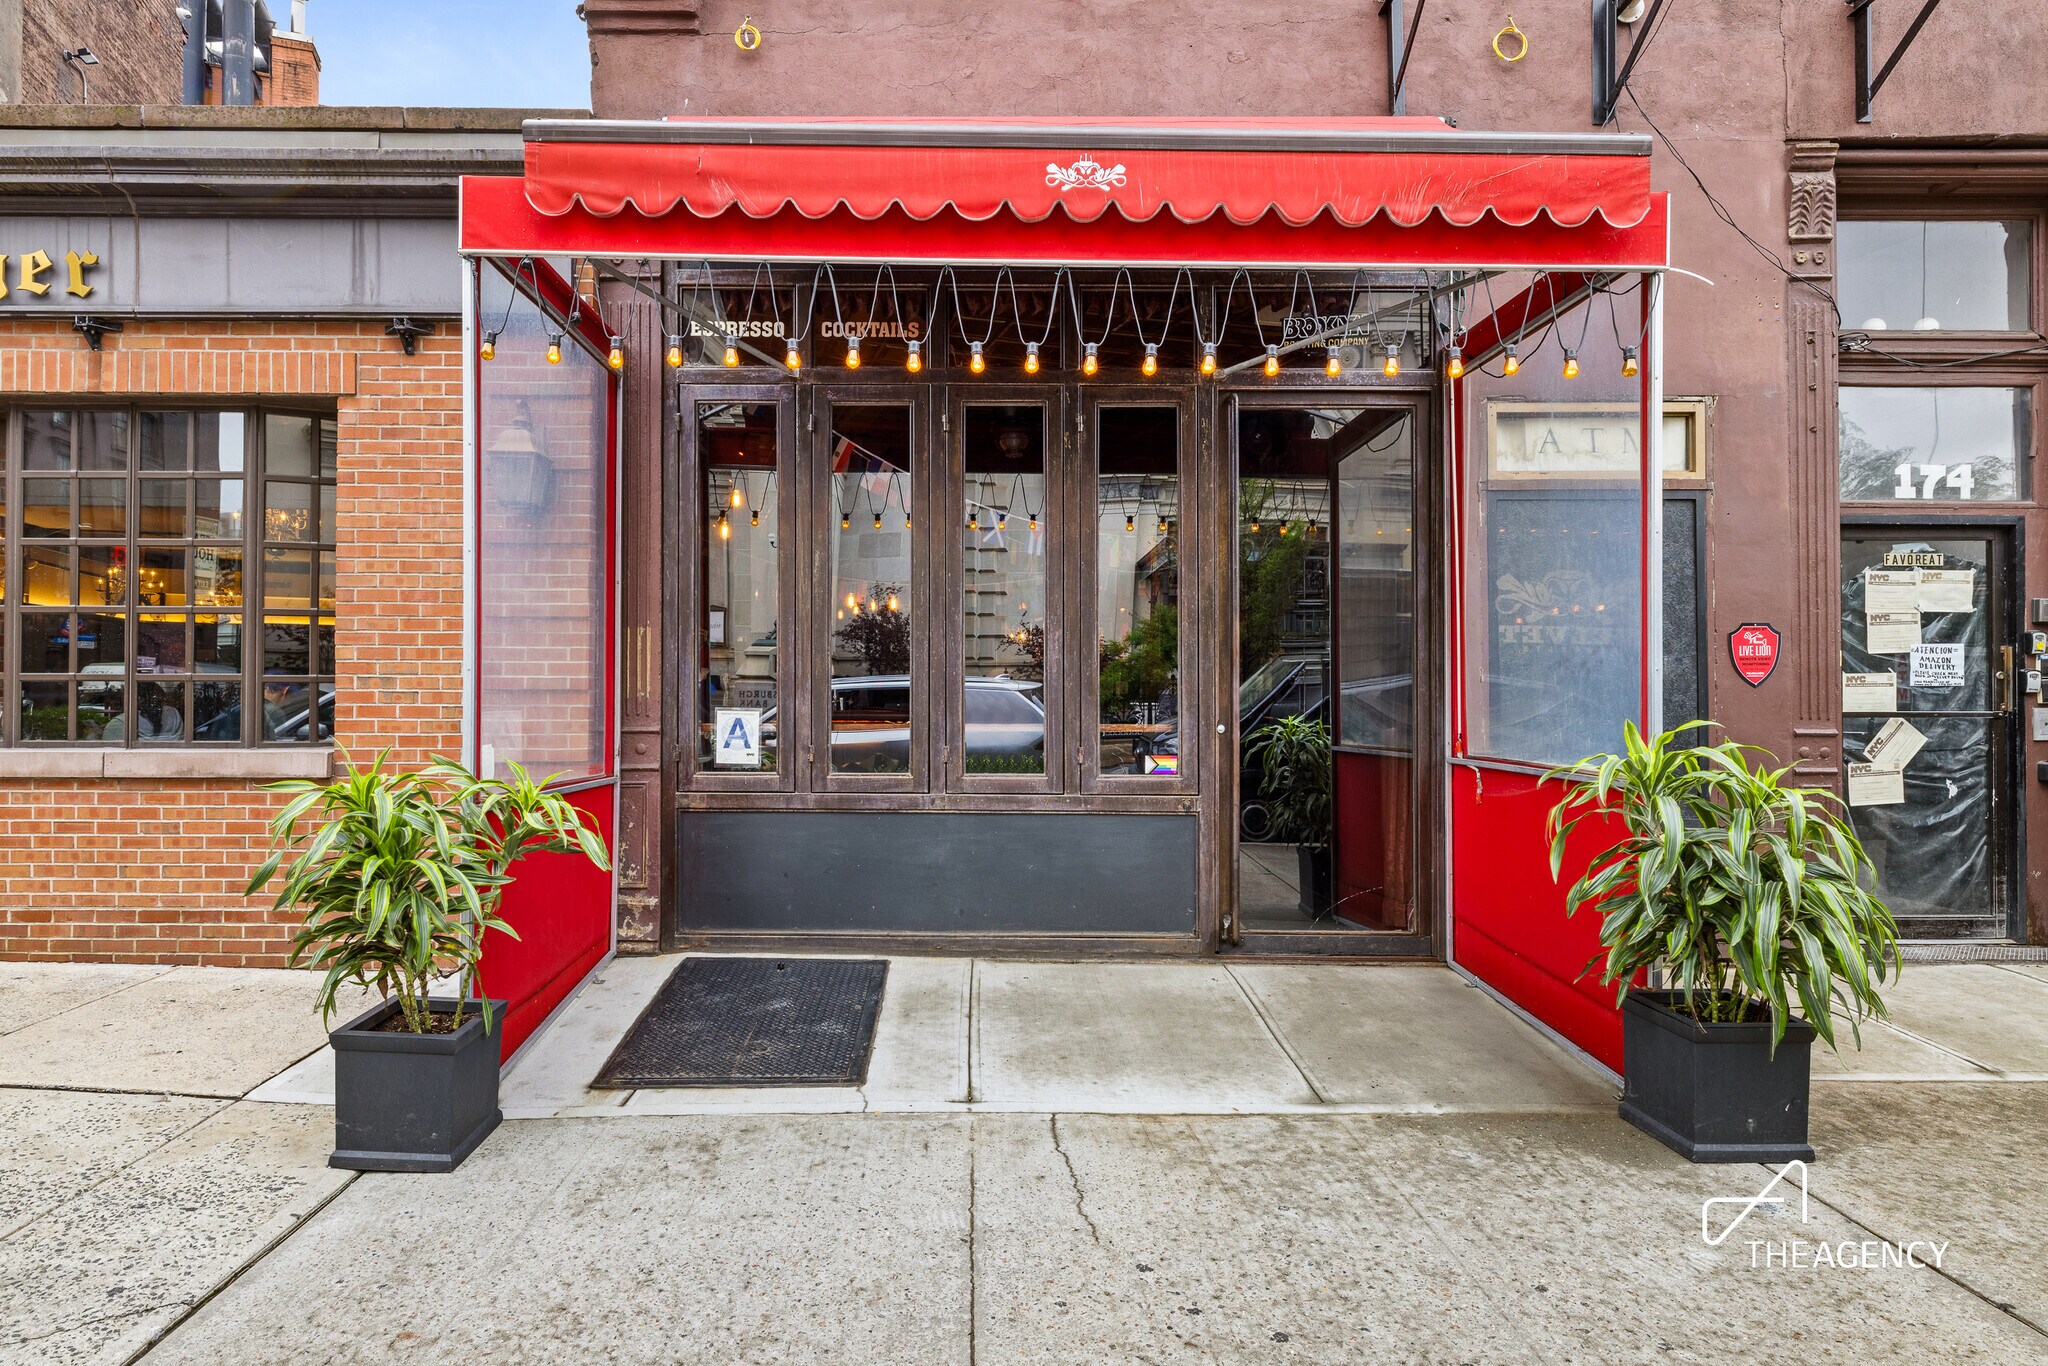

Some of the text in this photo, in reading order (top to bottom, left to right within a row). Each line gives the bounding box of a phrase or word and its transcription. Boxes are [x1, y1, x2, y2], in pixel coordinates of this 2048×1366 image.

[821, 321, 919, 338] COCKTAILS
[1894, 463, 1975, 500] 174
[1885, 554, 1943, 565] FAVOREAT
[1869, 573, 1890, 582] NYC
[1922, 572, 1942, 580] NYC
[1870, 614, 1891, 622] NYC
[1739, 645, 1771, 656] LIVE LION
[1919, 656, 1952, 664] AMAZON
[1918, 662, 1956, 671] DELIVERY
[1845, 675, 1866, 683] NYC
[723, 717, 752, 749] A
